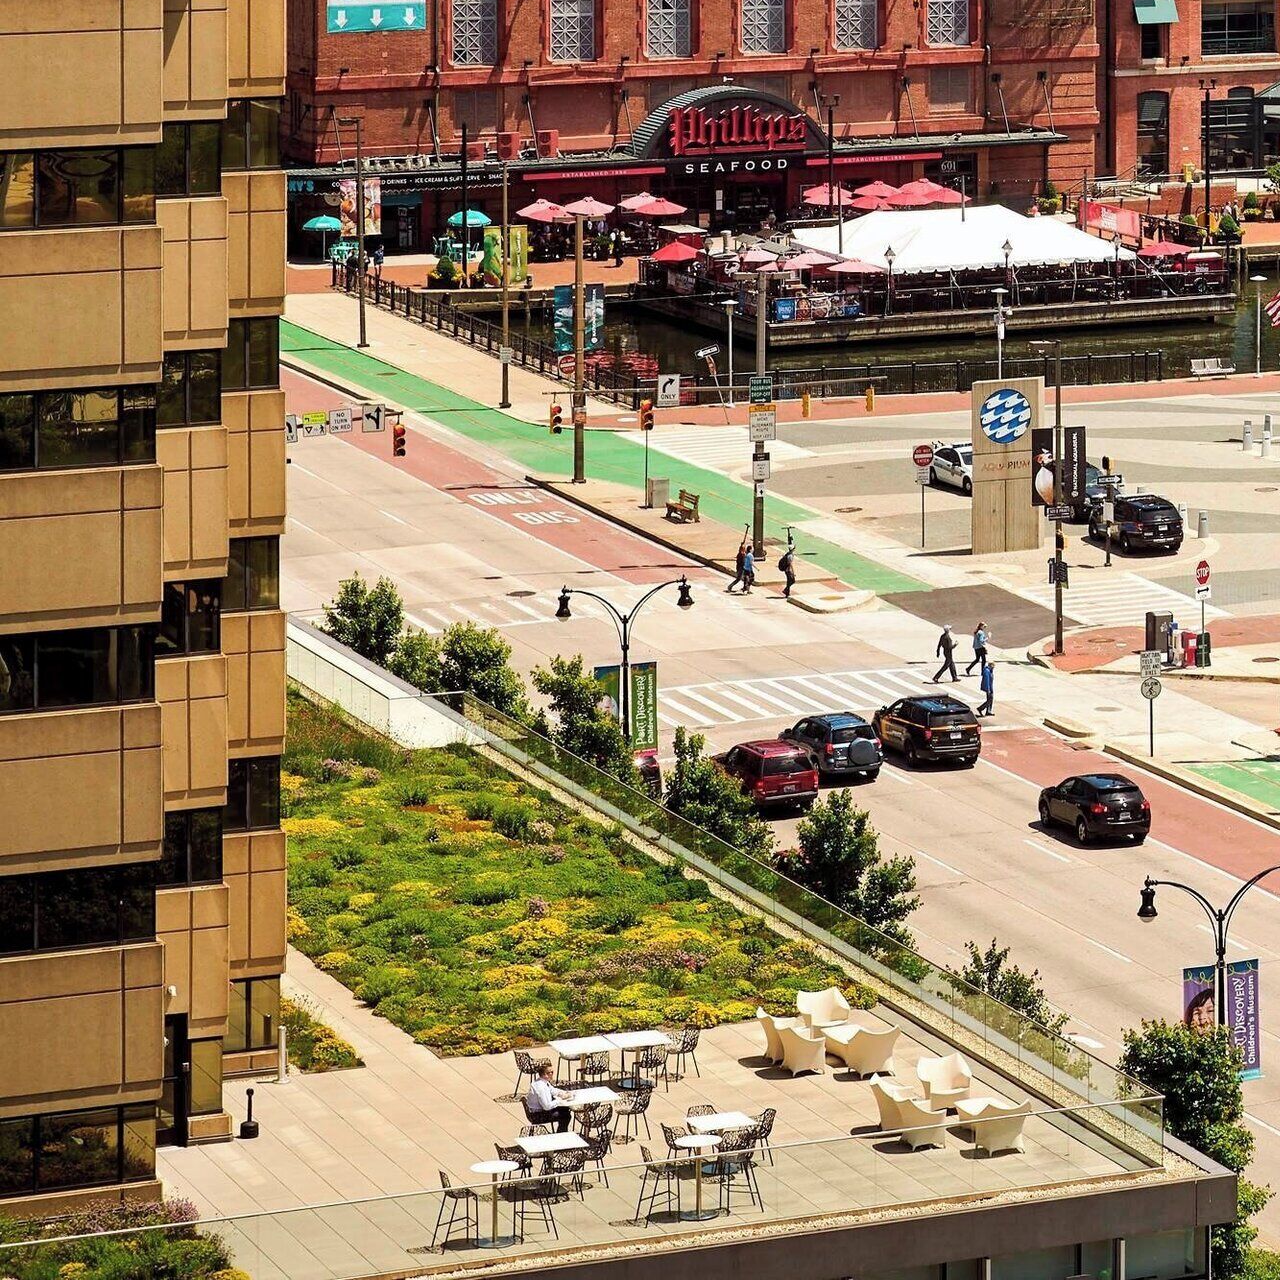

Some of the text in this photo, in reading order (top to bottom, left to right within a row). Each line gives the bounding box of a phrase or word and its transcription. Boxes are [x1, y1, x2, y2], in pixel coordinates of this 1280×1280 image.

[669, 105, 807, 156] Phillips
[685, 159, 788, 174] SEAFOOD
[941, 161, 956, 170] 601
[467, 491, 542, 505] ONLY
[512, 511, 580, 525] BUS
[1196, 567, 1209, 578] STOP
